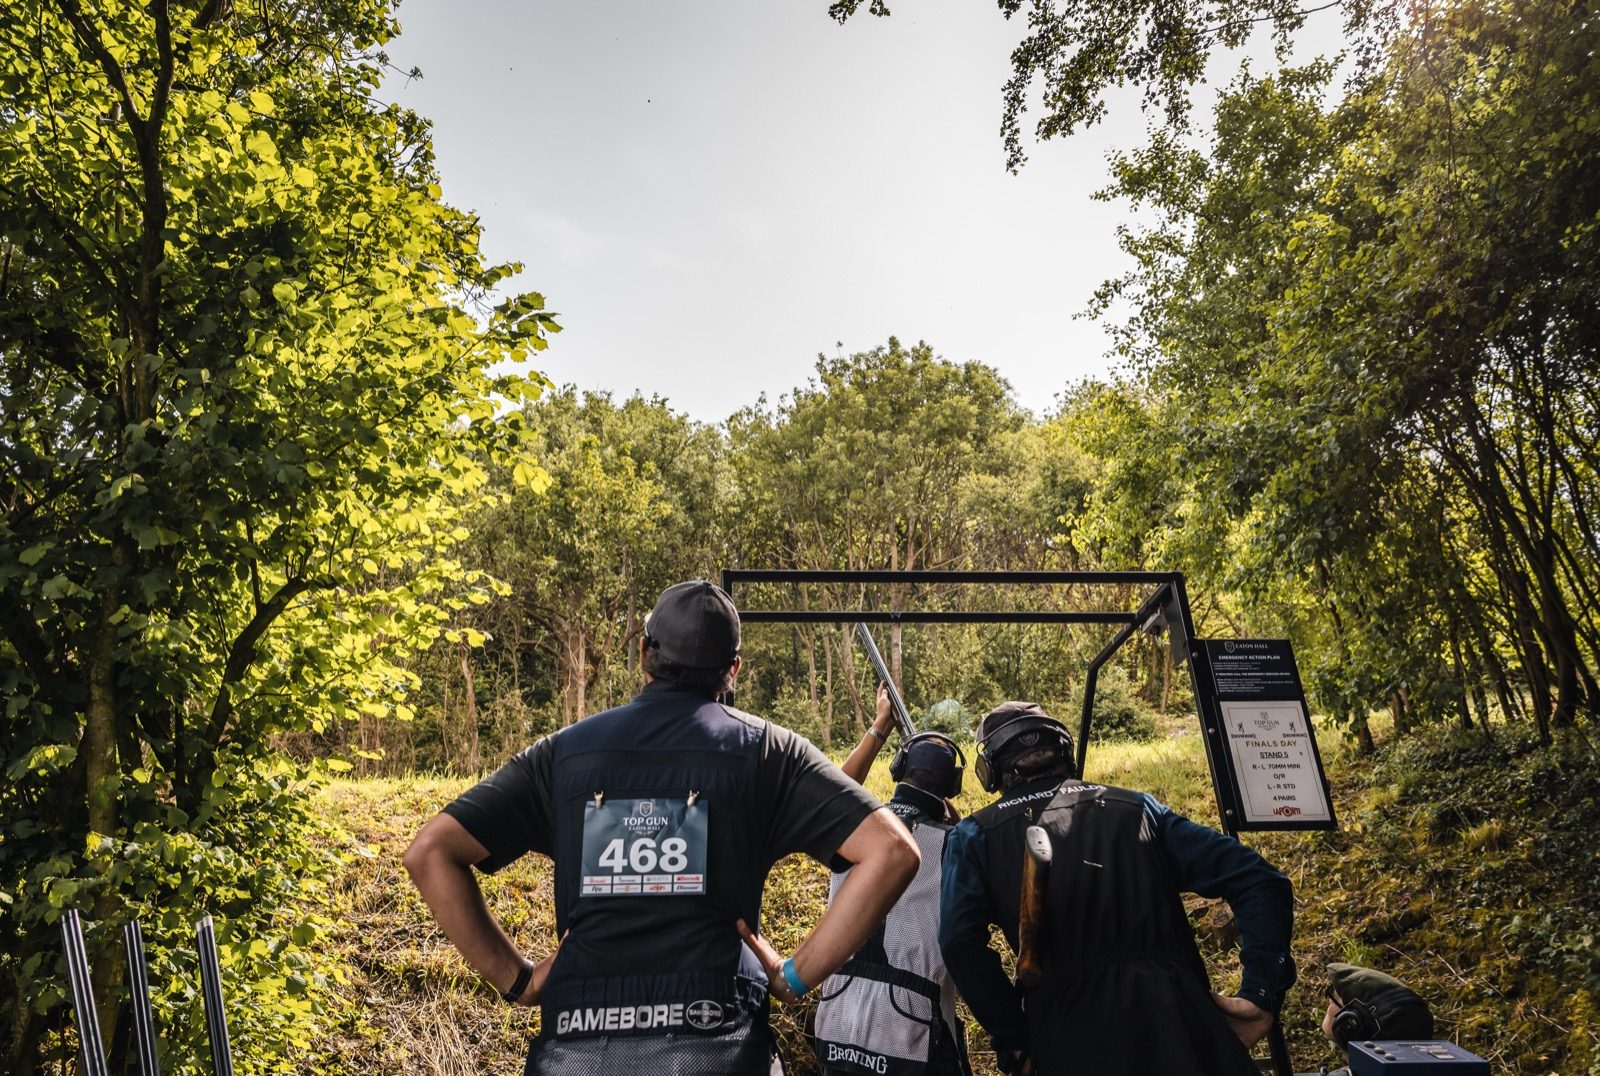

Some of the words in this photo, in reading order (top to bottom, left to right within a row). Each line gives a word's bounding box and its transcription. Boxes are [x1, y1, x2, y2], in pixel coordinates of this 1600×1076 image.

[997, 790, 1054, 810] RICHARD
[623, 817, 645, 826] TOP
[645, 817, 669, 826] GUN
[598, 837, 688, 873] 468
[556, 1003, 685, 1035] GAMEBORE
[827, 1043, 888, 1074] BRNING
